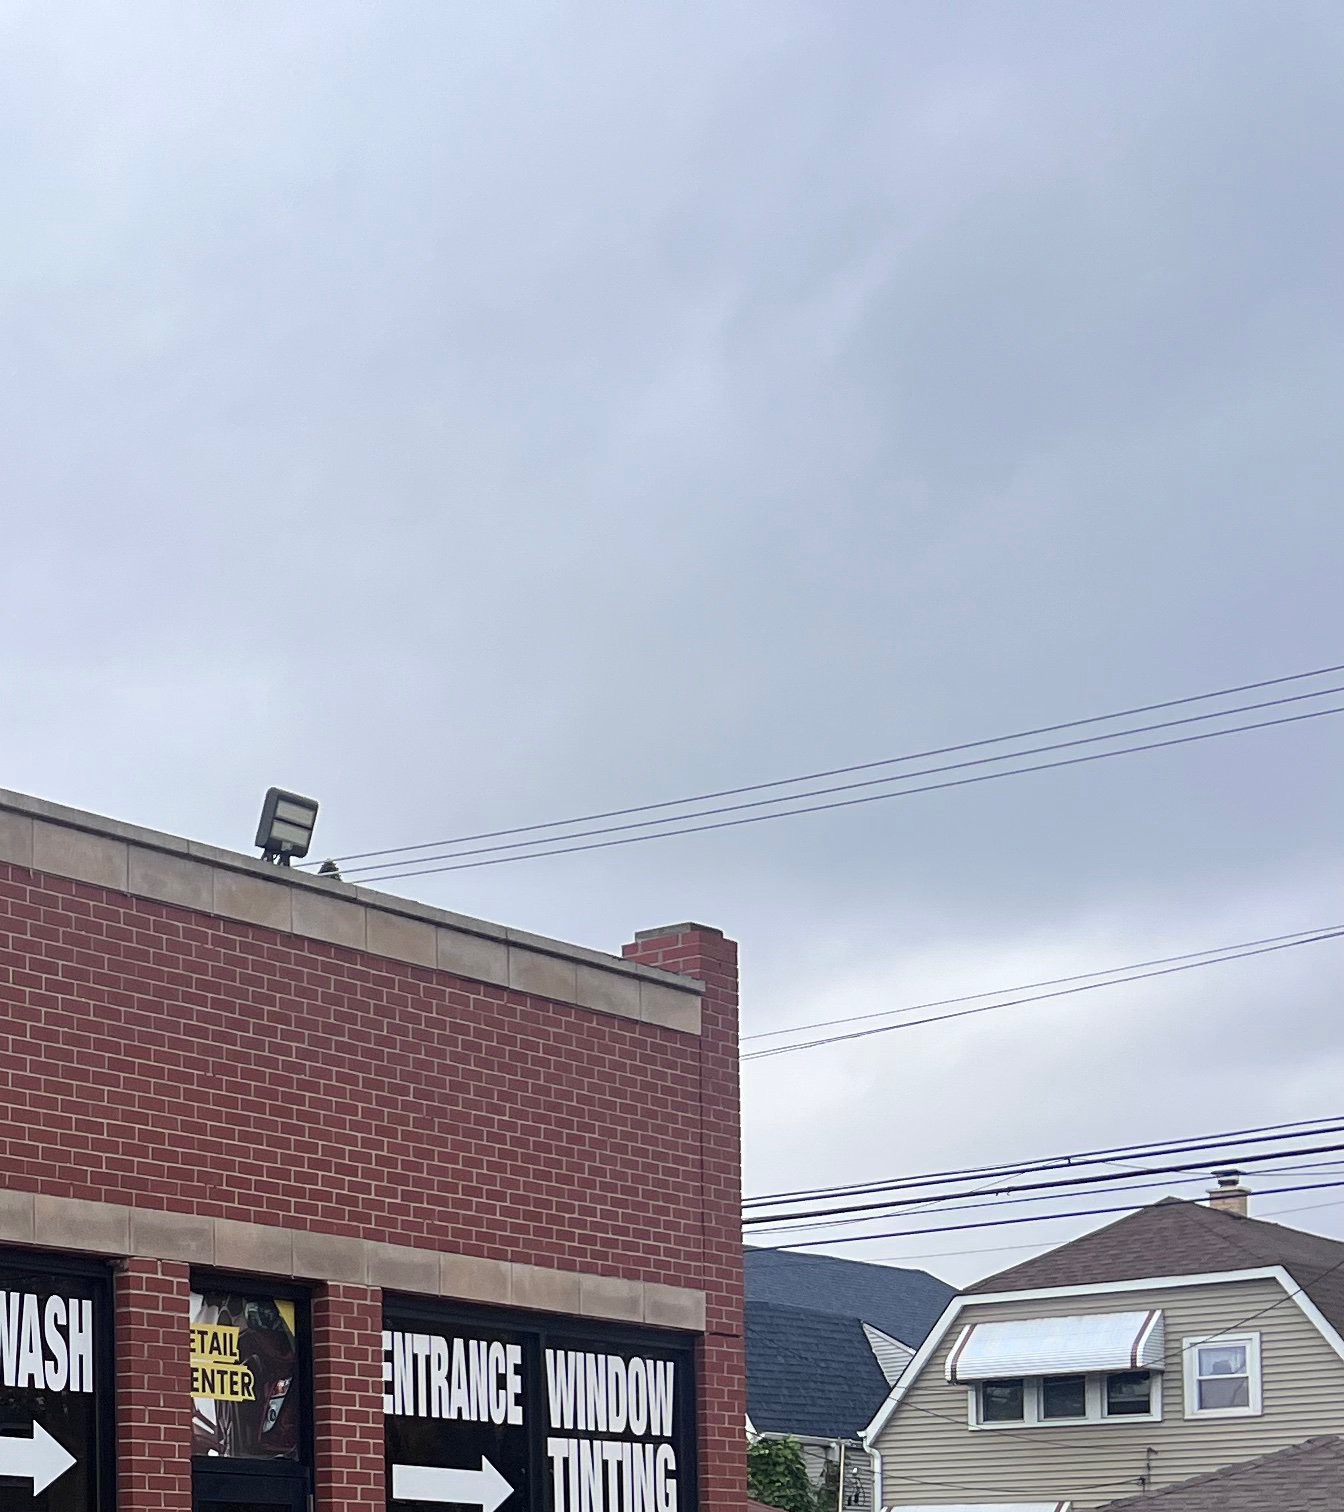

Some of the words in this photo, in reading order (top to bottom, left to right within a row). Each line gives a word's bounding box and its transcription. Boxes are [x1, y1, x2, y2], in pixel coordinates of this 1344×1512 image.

[190, 1329, 237, 1357] ETAIL
[191, 1367, 253, 1397] ENTER
[382, 1330, 523, 1425] ENTRANCE
[545, 1349, 674, 1437] WINDOW
